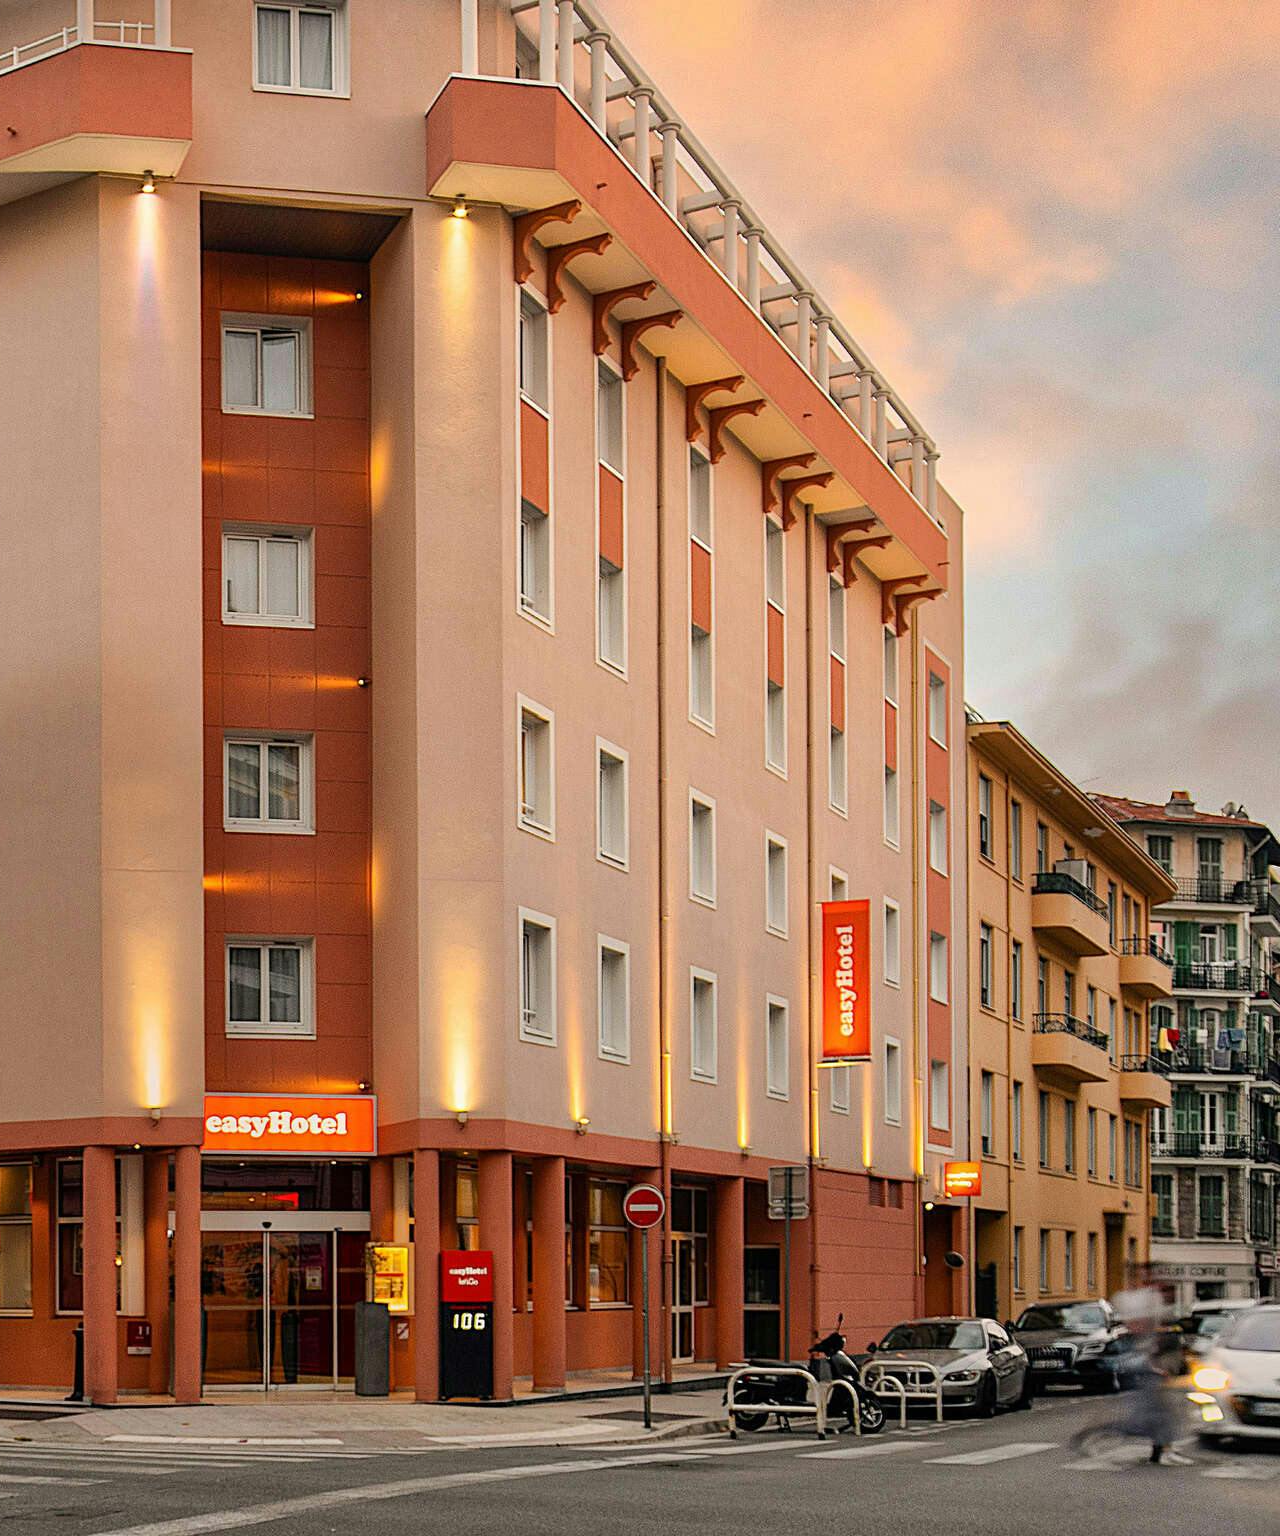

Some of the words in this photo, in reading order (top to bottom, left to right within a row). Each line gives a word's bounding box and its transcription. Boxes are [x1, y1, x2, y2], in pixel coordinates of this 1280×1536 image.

[836, 925, 857, 1036] easyHotel
[205, 1111, 347, 1138] easyHotel
[453, 1312, 486, 1330] 106
